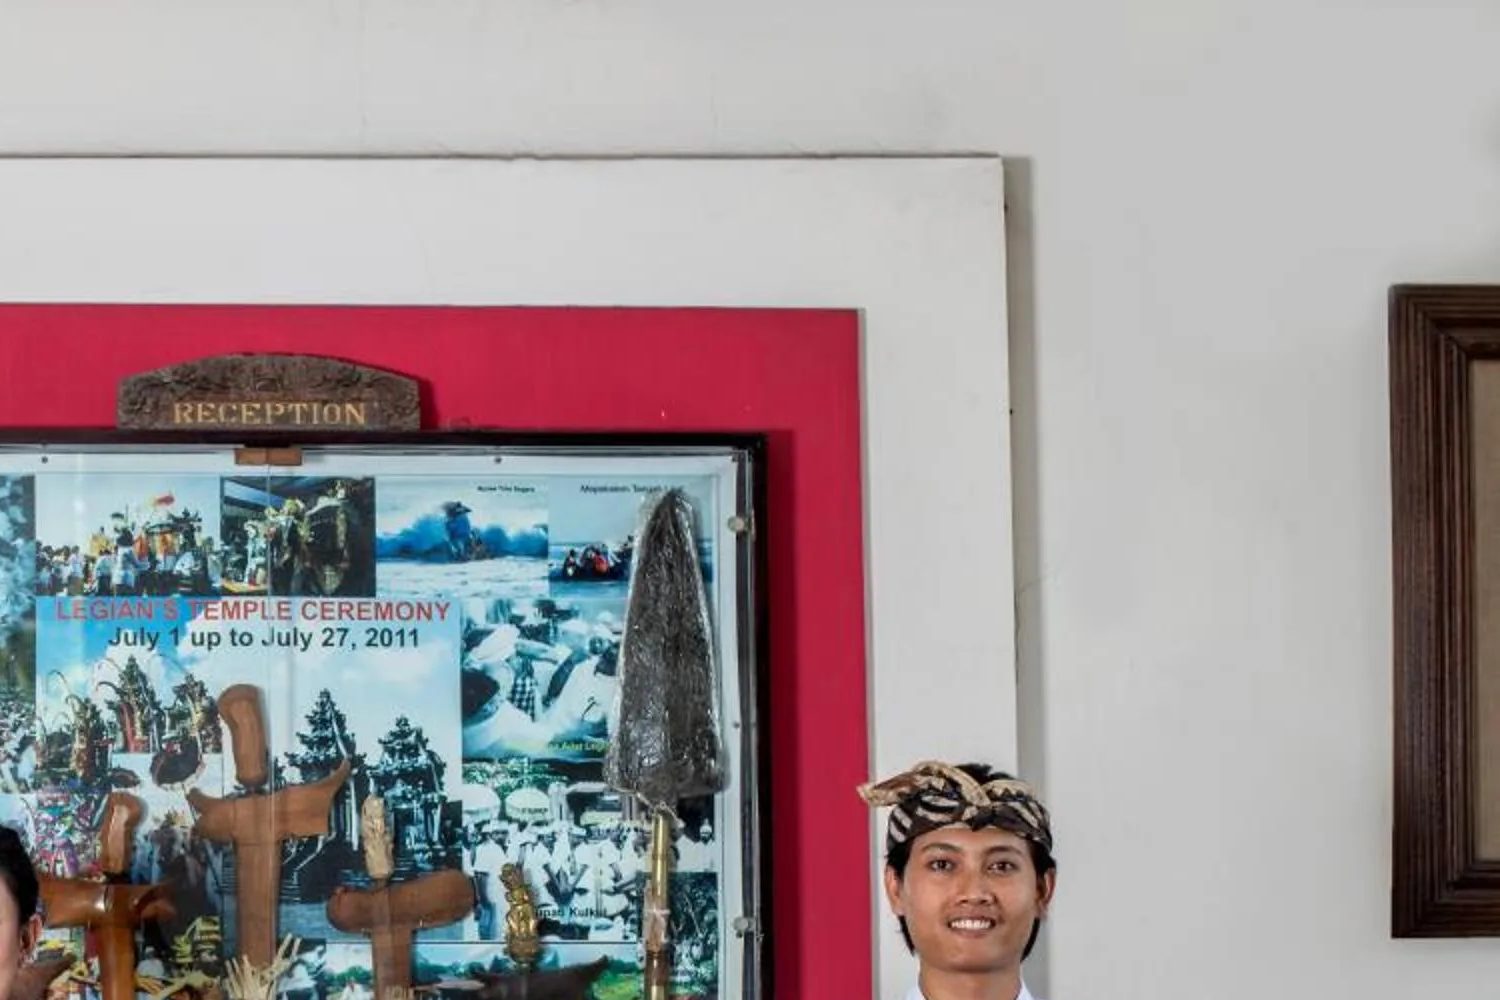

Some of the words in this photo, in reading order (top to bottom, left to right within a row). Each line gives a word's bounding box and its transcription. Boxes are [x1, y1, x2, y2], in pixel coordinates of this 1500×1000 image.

[172, 402, 366, 426] RECEPTION
[57, 601, 178, 620] LEGIAN'S
[190, 601, 292, 621] TEMPLE
[301, 601, 450, 621] CEREMONY
[108, 627, 159, 650] July
[169, 628, 180, 646] 1
[191, 630, 221, 651] up
[231, 628, 254, 647] to
[261, 627, 313, 651] July
[321, 627, 357, 650] 27,
[365, 627, 419, 647] 2011
